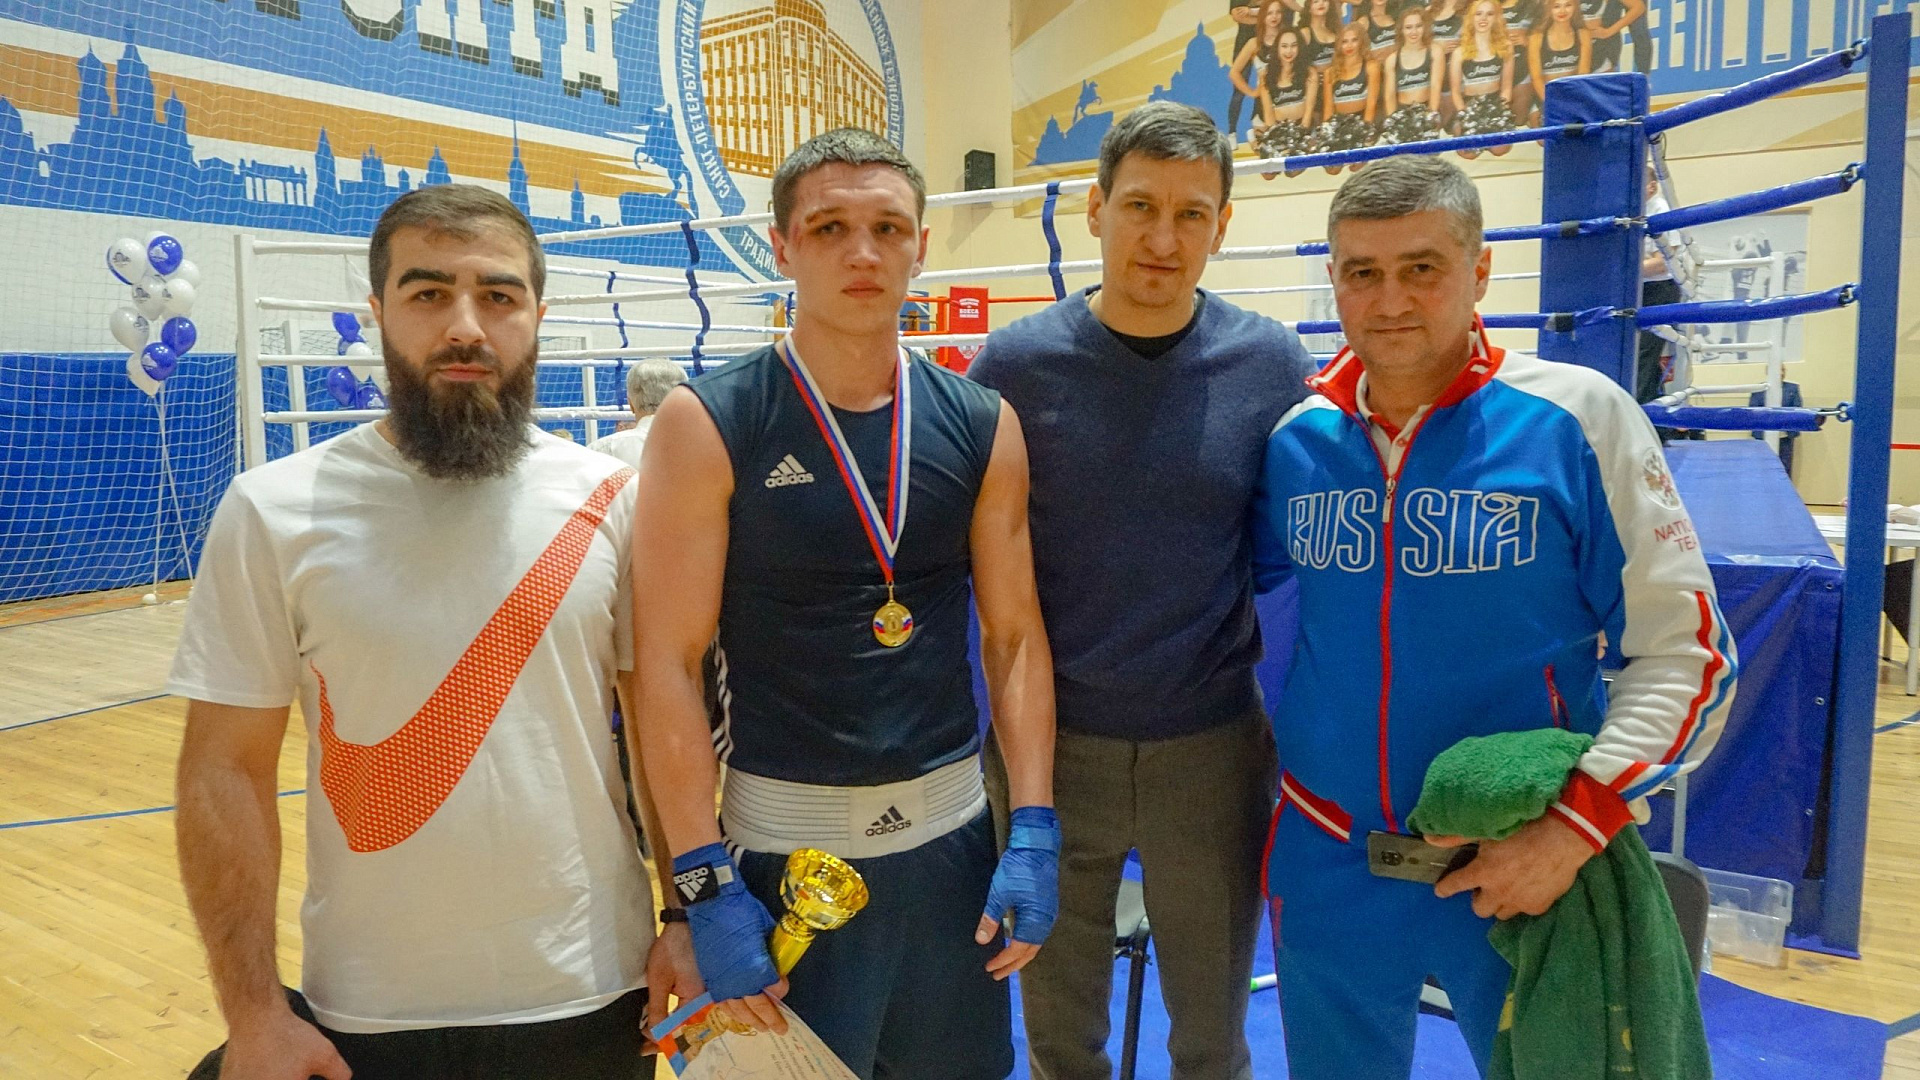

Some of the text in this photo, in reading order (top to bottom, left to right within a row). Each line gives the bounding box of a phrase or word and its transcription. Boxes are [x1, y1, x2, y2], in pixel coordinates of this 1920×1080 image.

[681, 0, 730, 199] САНКТ-ПЕТЕРБУРГСКИЙ
[740, 230, 783, 278] ТРАДИЦ
[765, 472, 814, 488] adidas
[1287, 487, 1540, 577] RUSSIA
[1653, 519, 1692, 542] NATI
[1673, 535, 1697, 553] TE
[865, 819, 912, 837] adidas
[673, 866, 709, 885] adidas
